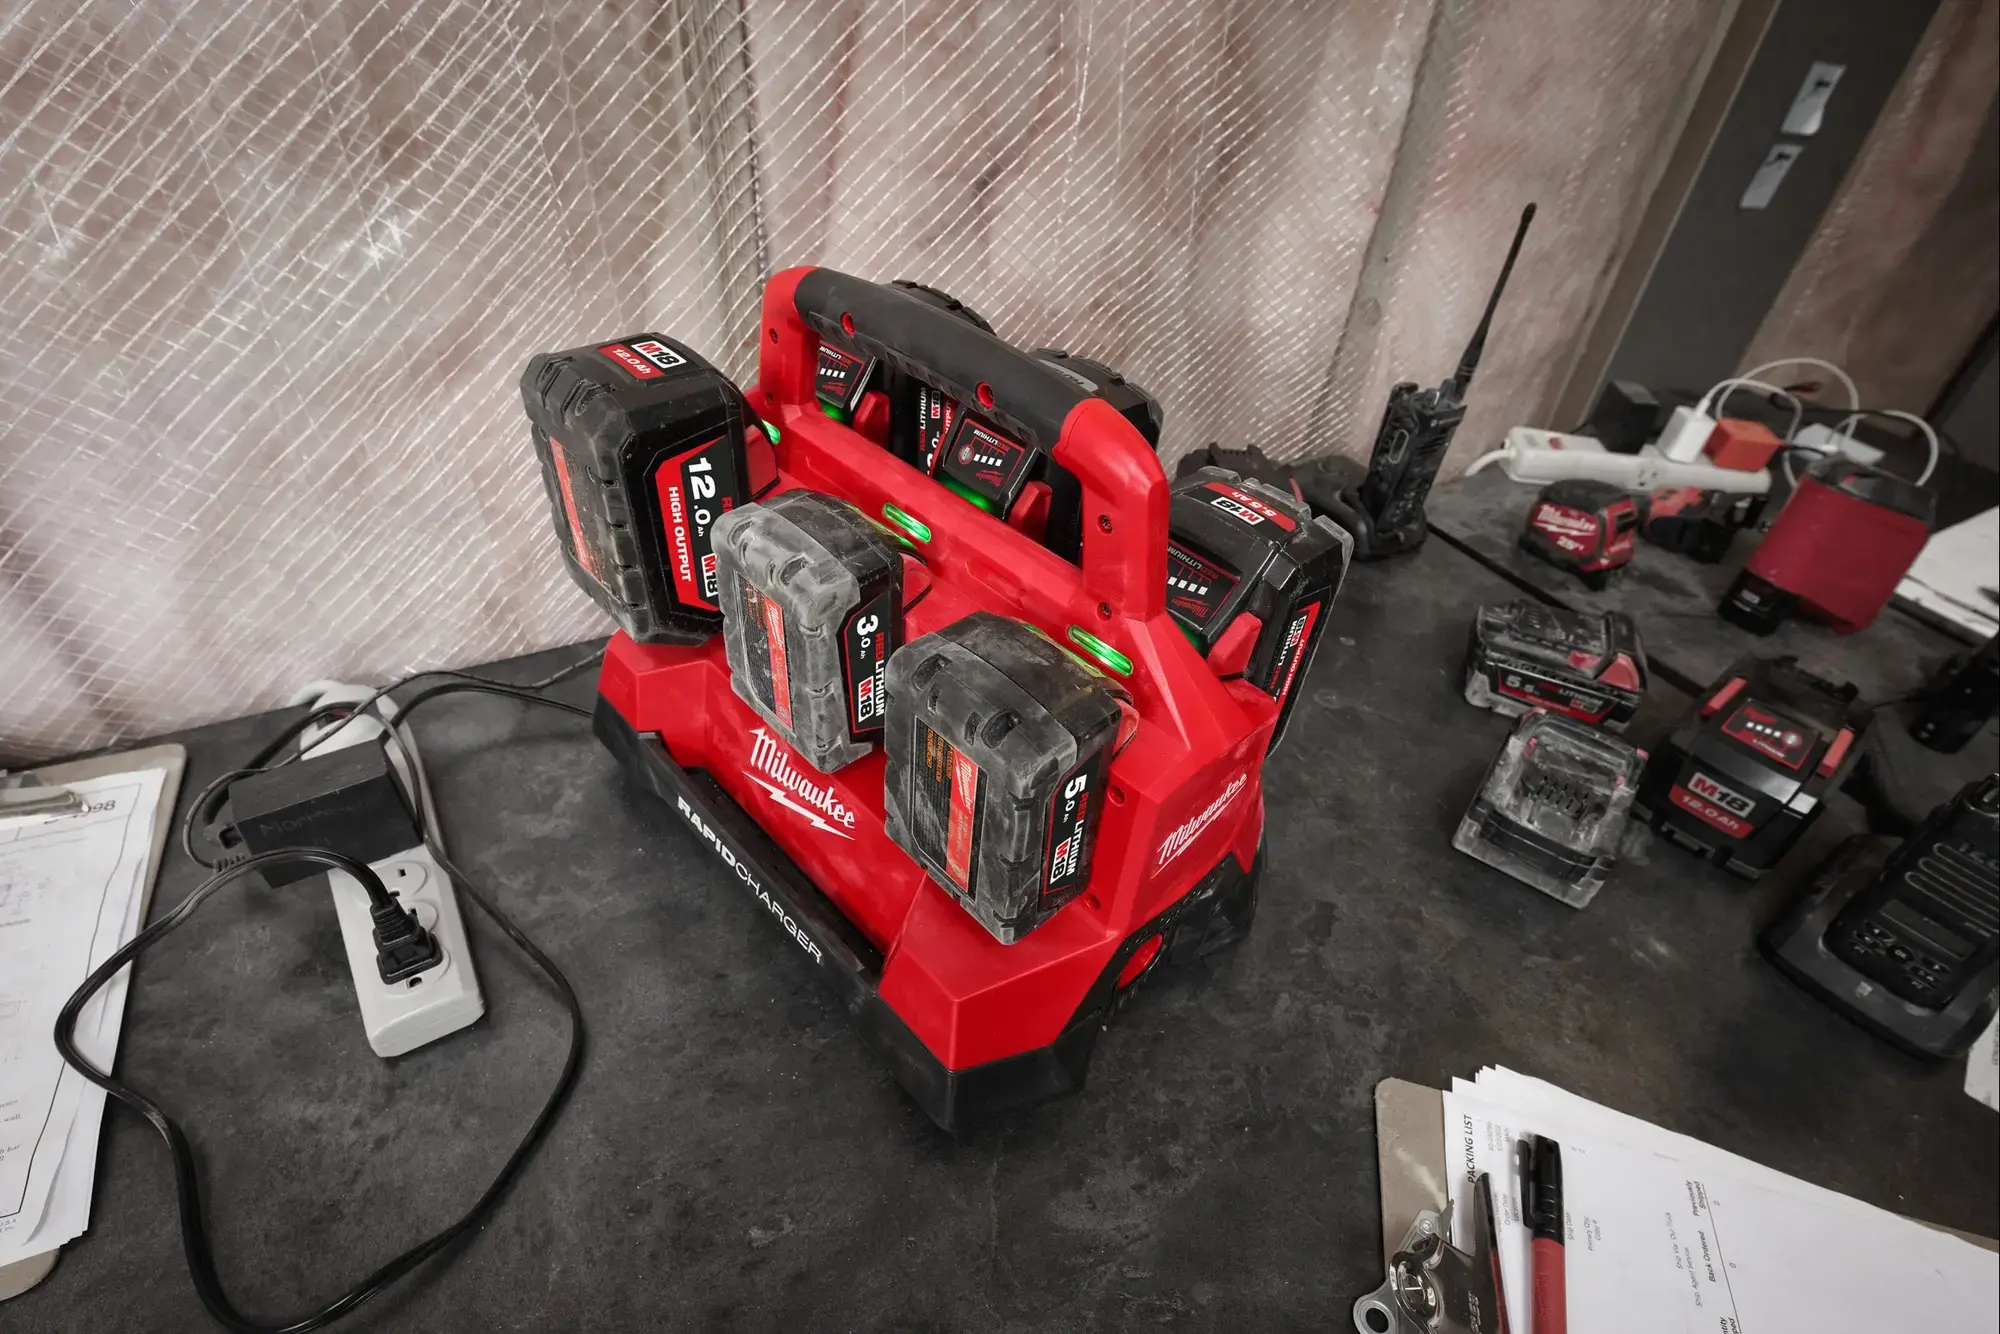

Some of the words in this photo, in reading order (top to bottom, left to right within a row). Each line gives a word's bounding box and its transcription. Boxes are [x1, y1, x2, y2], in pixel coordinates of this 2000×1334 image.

[636, 343, 680, 365] M18
[931, 391, 940, 418] M18
[974, 429, 1010, 452] REDLITHIUM
[668, 486, 683, 523] HIGH
[1216, 499, 1260, 522] M18
[674, 526, 692, 582] OUTPUT
[703, 554, 717, 594] M18
[875, 632, 885, 717] REDLITHIUM
[1282, 673, 1293, 695] HIGH
[1290, 639, 1304, 672] OUTPUT
[859, 677, 873, 719] M18
[749, 728, 855, 829] Milwaukee
[1692, 776, 1750, 812] M18
[1066, 791, 1089, 876] REDLITHIUM
[1158, 773, 1248, 865] Milwaukee
[1052, 839, 1071, 881] M18
[1464, 1114, 1474, 1135] LIST
[1465, 1136, 1477, 1184] PACKING
[1684, 1180, 1701, 1217] Previously
[1691, 1181, 1707, 1210] Shipped
[1699, 1231, 1710, 1262] Ordered
[1708, 1262, 1717, 1283] Back
